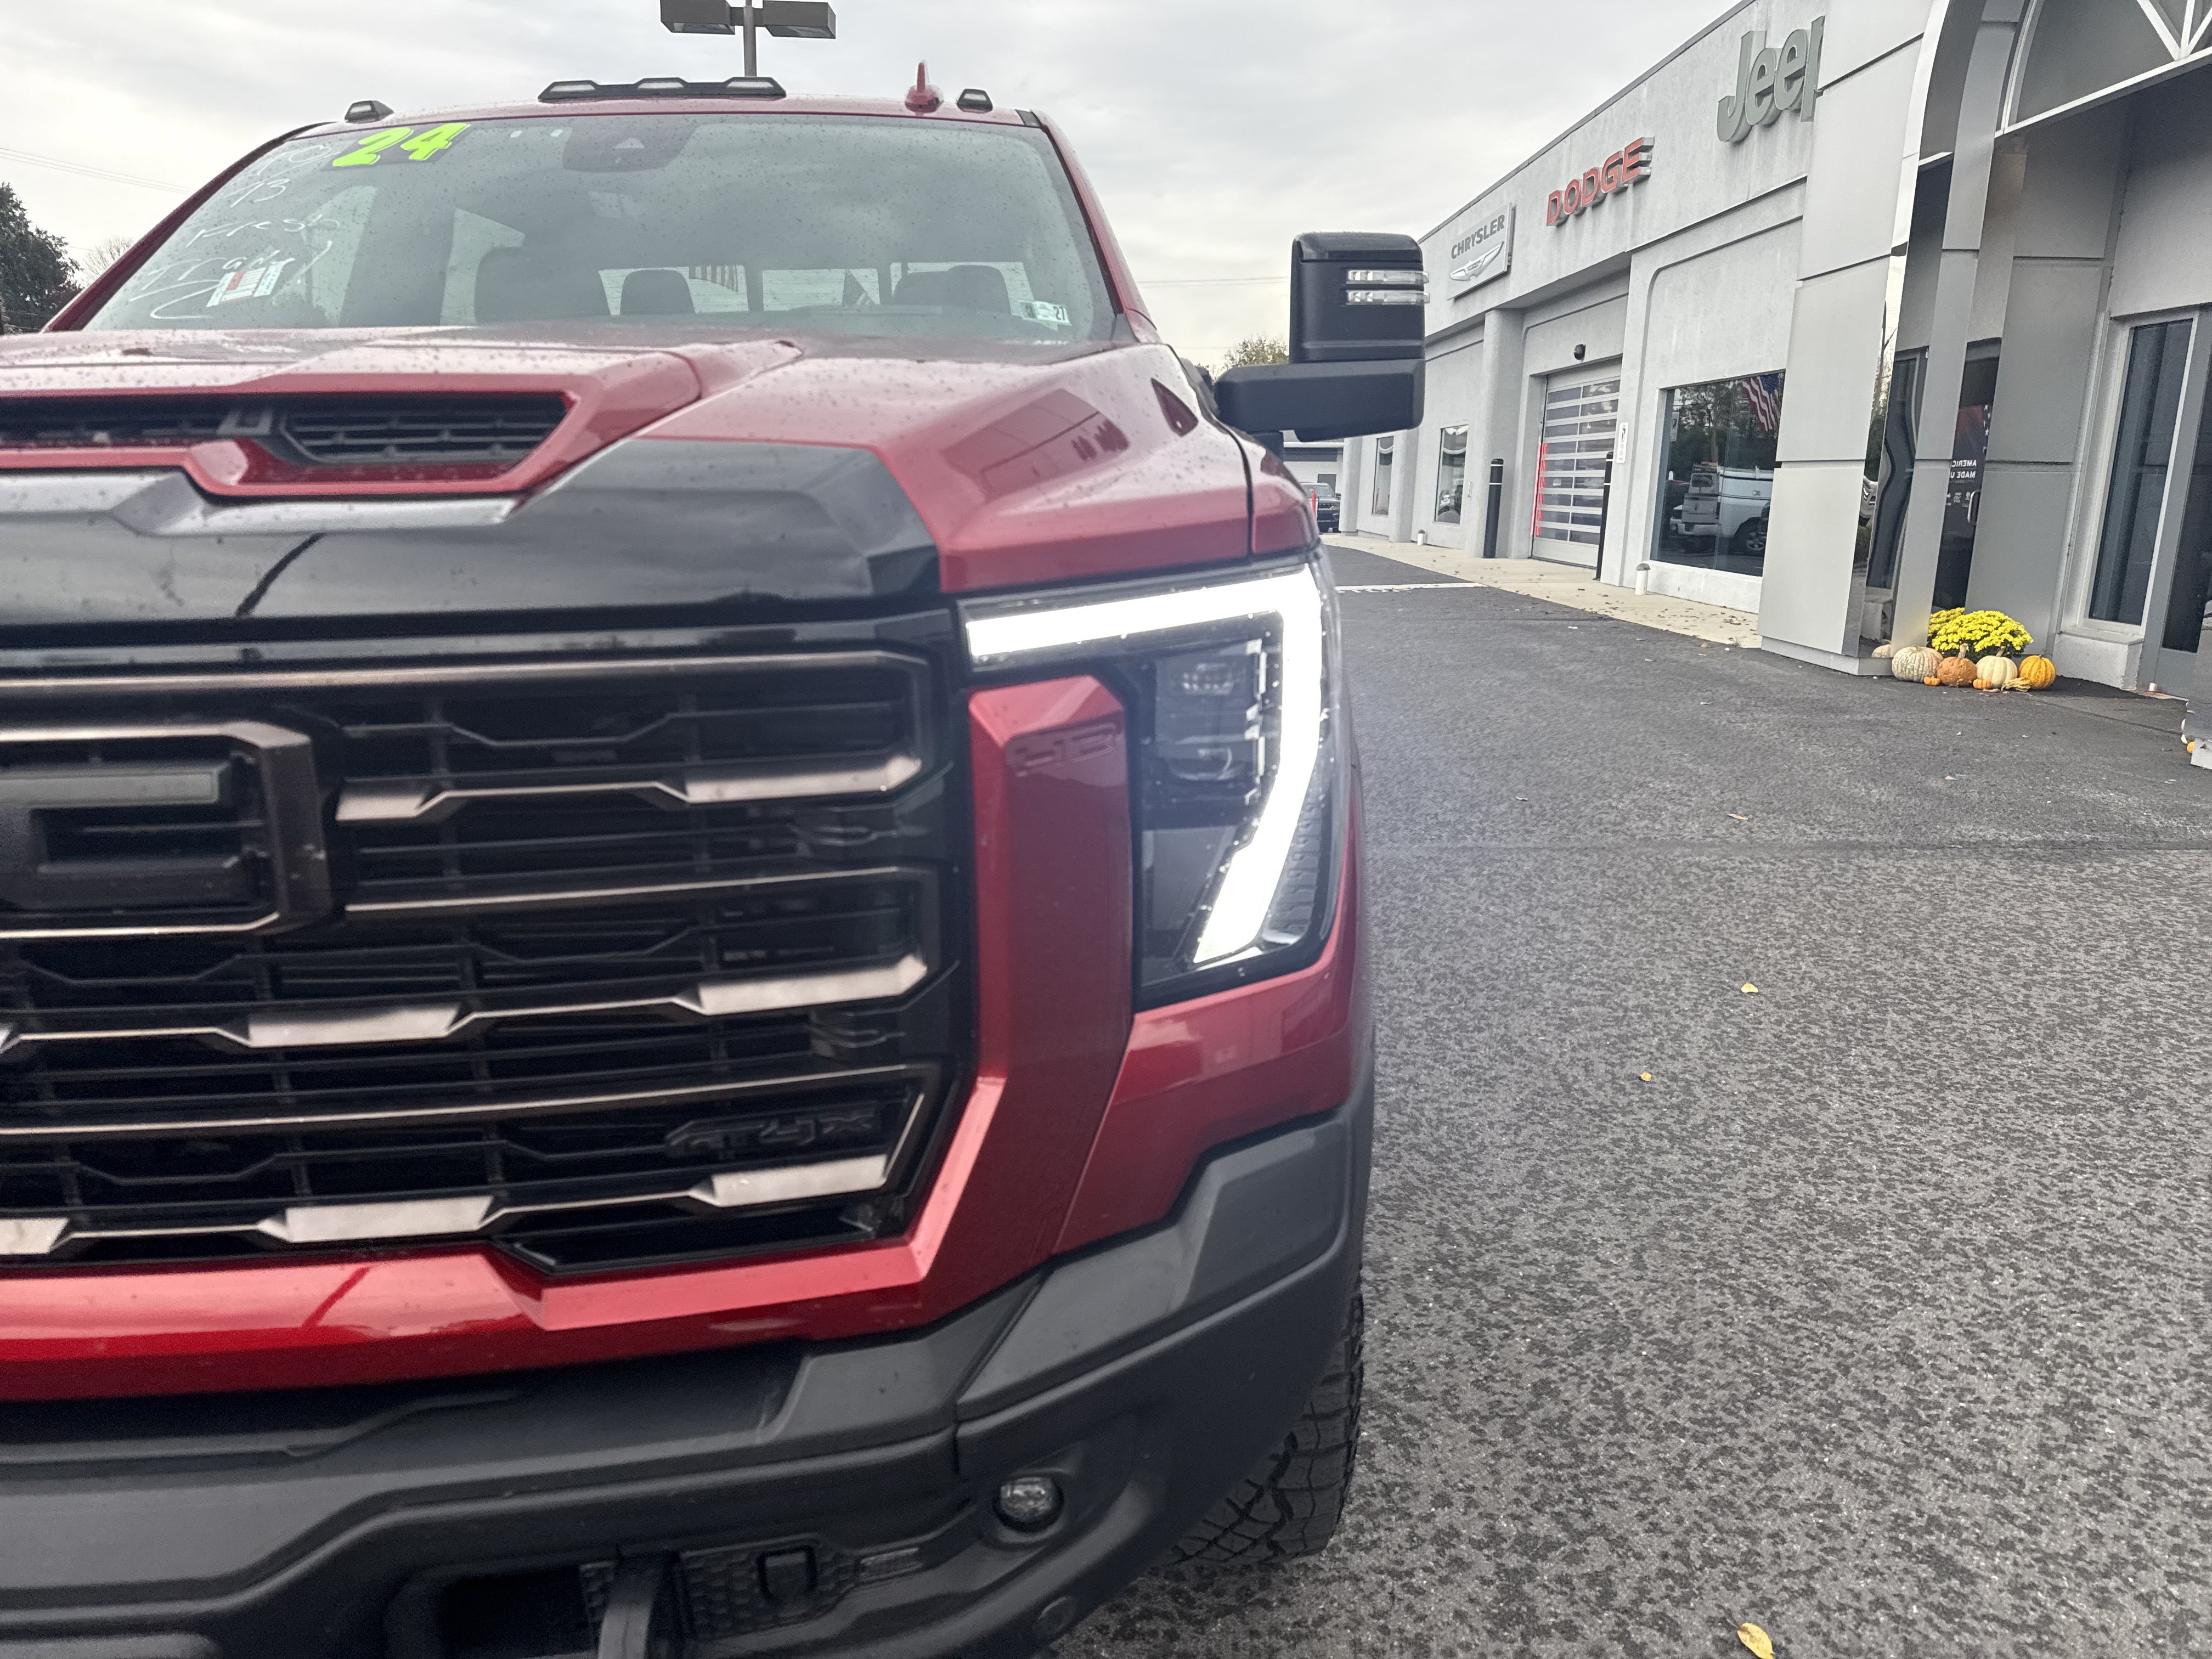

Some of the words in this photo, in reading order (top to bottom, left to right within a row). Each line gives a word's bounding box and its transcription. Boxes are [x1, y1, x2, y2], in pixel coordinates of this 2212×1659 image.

[332, 123, 471, 167] 24
[1547, 137, 1653, 227] DODGE
[1451, 215, 1505, 259] CHRYSLER
[1053, 306, 1065, 321] 27
